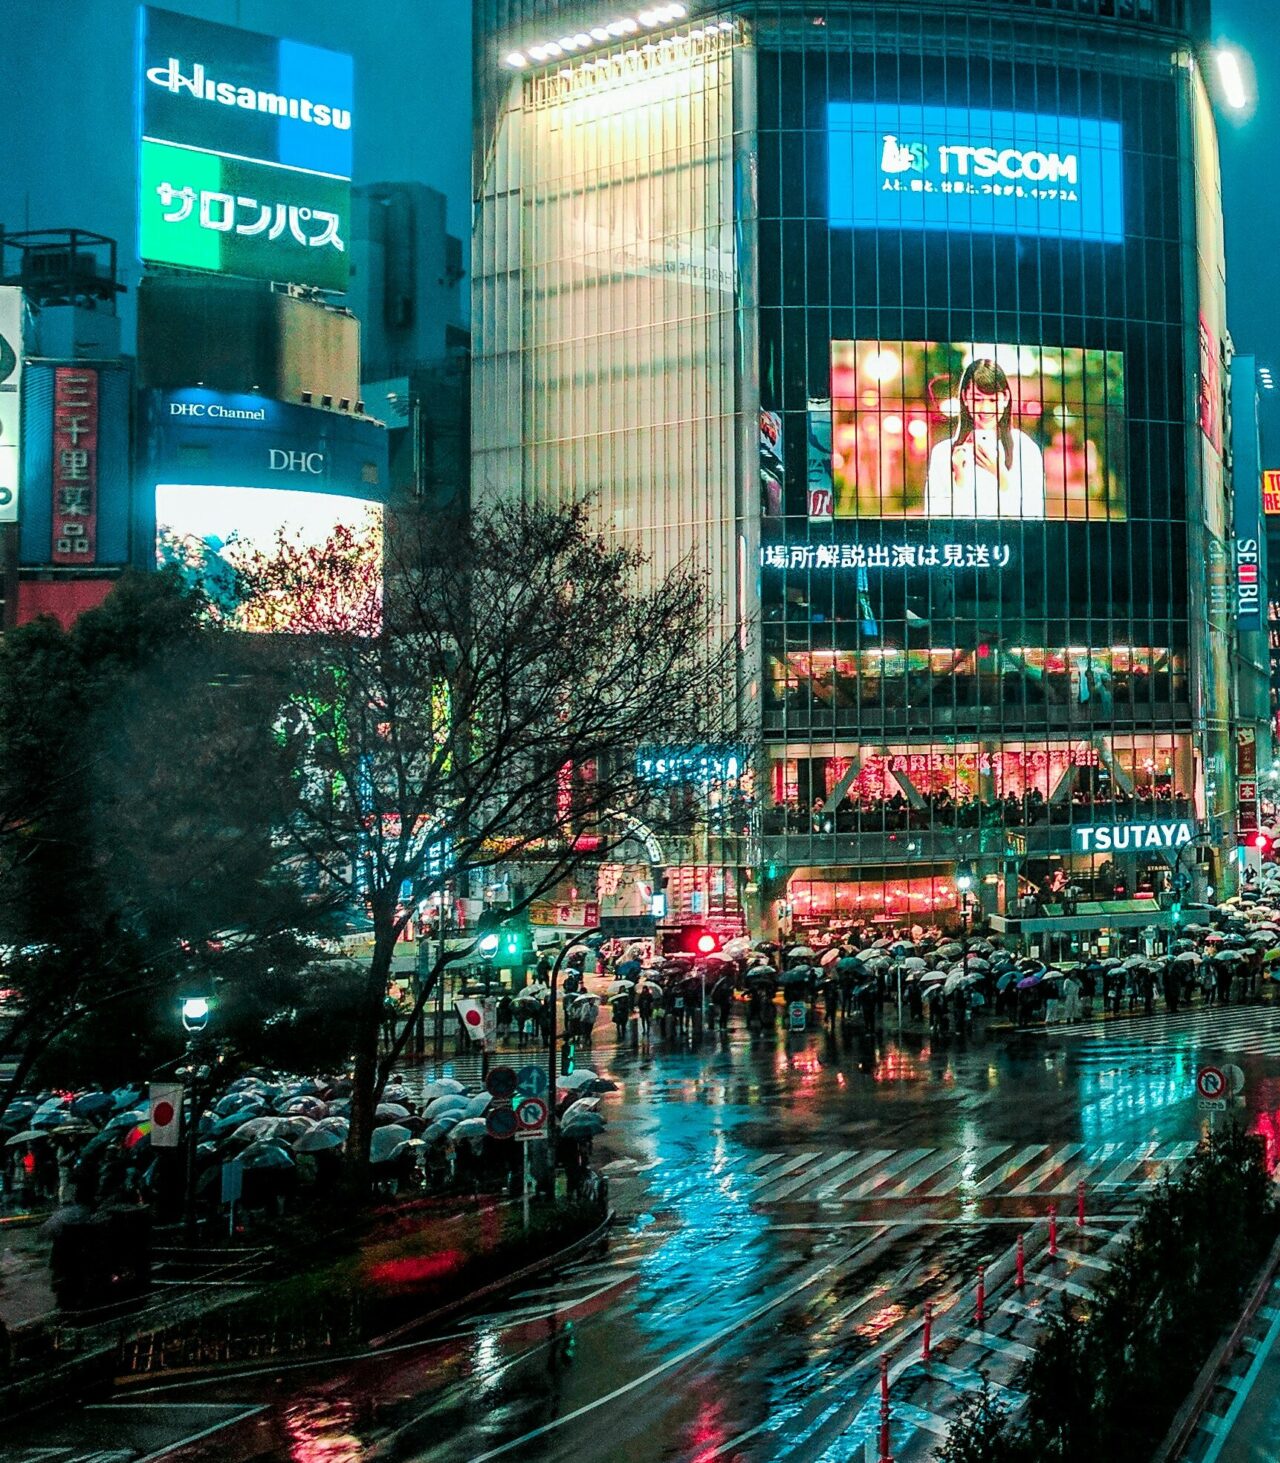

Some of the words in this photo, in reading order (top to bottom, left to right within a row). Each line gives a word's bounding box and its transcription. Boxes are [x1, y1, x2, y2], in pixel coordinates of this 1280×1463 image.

[147, 58, 351, 131] Hisamitsu
[157, 182, 345, 252] サロンパス
[170, 403, 205, 416] DHC
[208, 405, 265, 421] Channel
[57, 375, 91, 555] 三千里薬品
[269, 449, 323, 475] DHC
[760, 544, 1010, 568] 場所解説出演は見送り
[1238, 539, 1258, 614] SEIBU
[1076, 824, 1193, 850] TSUTAYA
